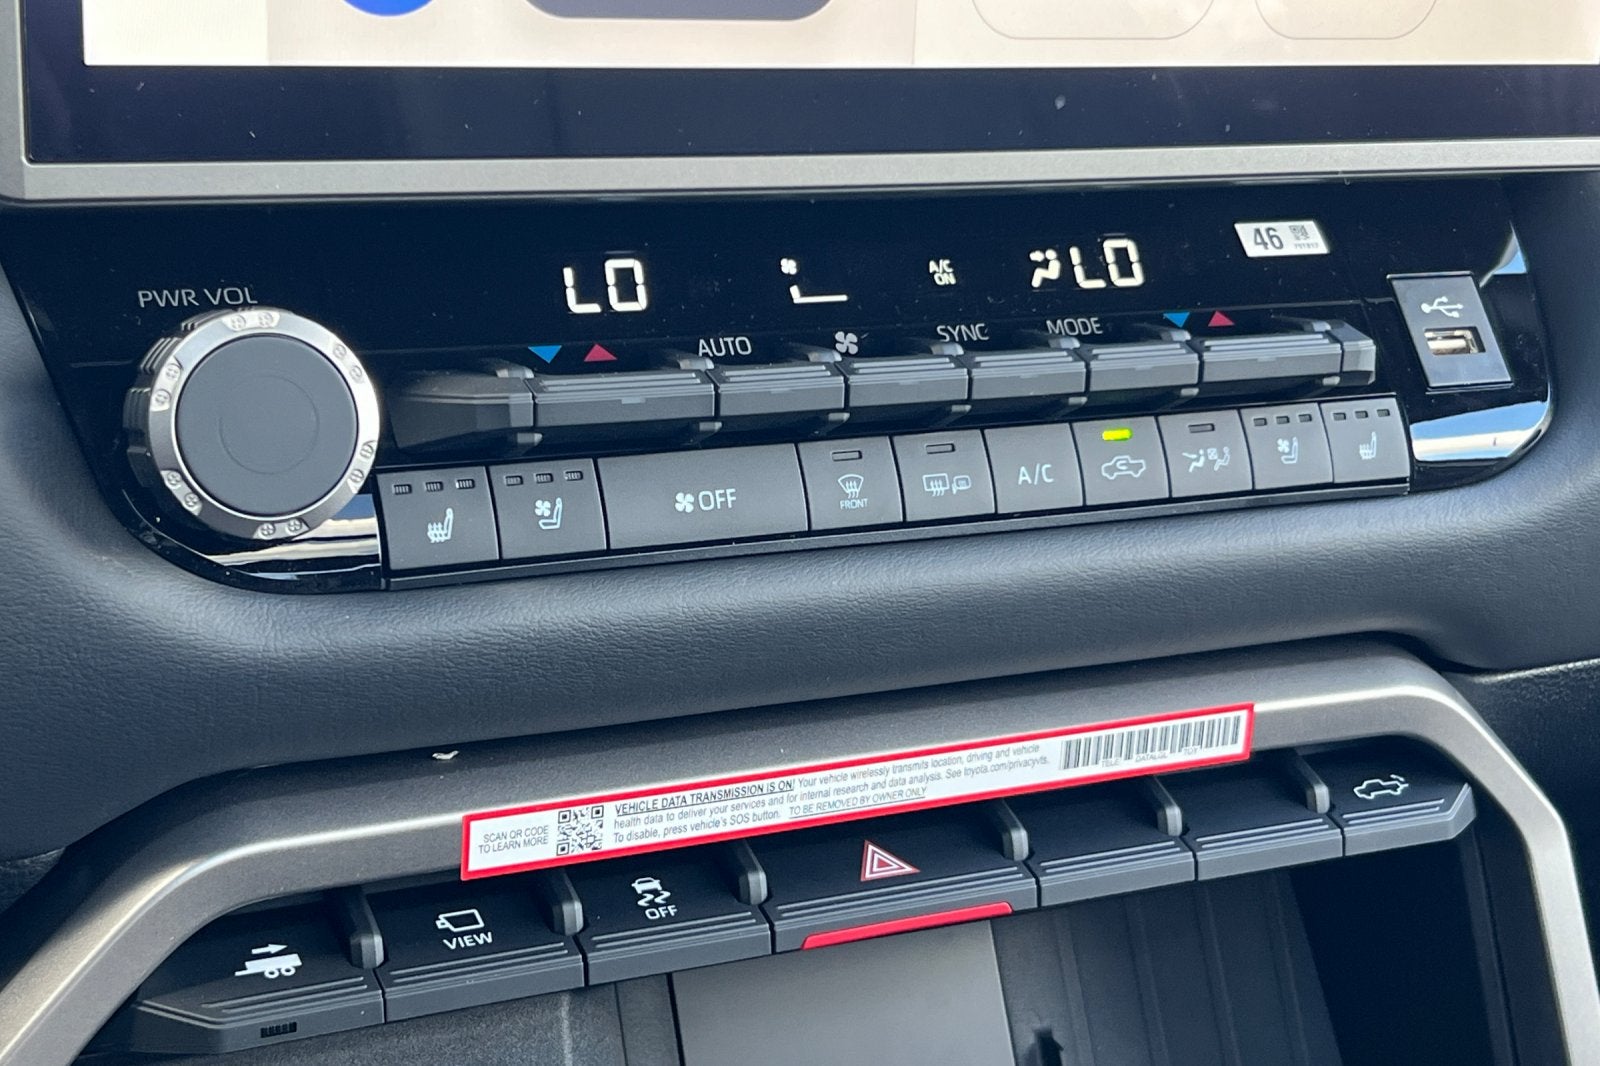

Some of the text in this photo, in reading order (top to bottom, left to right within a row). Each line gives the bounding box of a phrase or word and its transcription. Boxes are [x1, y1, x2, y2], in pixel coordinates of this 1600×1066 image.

[1253, 227, 1284, 250] 46
[929, 259, 953, 274] A/C
[1069, 238, 1145, 289] LO
[563, 258, 648, 314] LO
[934, 272, 956, 286] ON
[138, 287, 258, 308] PWR VOL
[936, 323, 990, 342] SYNC
[1046, 317, 1103, 337] MODE
[698, 336, 752, 357] AUTO
[1017, 463, 1054, 486] A/C
[698, 488, 737, 512] OFF
[839, 498, 869, 510] FRONT
[614, 744, 1040, 816] VEHICLE DATA TRANSMISSION IS ON! Your vehicle wirelessly transmits location, driving and vehicle
[614, 816, 641, 829] health
[644, 813, 663, 825] data
[667, 811, 675, 821] to
[677, 807, 707, 820] deliver
[709, 805, 728, 817] your
[730, 799, 766, 812] services
[768, 795, 784, 806] and
[786, 792, 798, 803] for
[800, 787, 831, 801] internal
[833, 781, 869, 795] research
[871, 779, 887, 790] and
[888, 776, 906, 788] data
[908, 771, 942, 784] analysis.
[945, 768, 962, 779] See
[614, 786, 927, 843] To disable, press vehicle's SOS button. TO BE REMOVED BY OWNER ONLY
[478, 835, 549, 854] TO LEARN MORE
[483, 831, 507, 843] SCAN
[524, 825, 549, 838] CODE
[644, 905, 678, 920] OFF
[443, 931, 493, 950] VIEW
